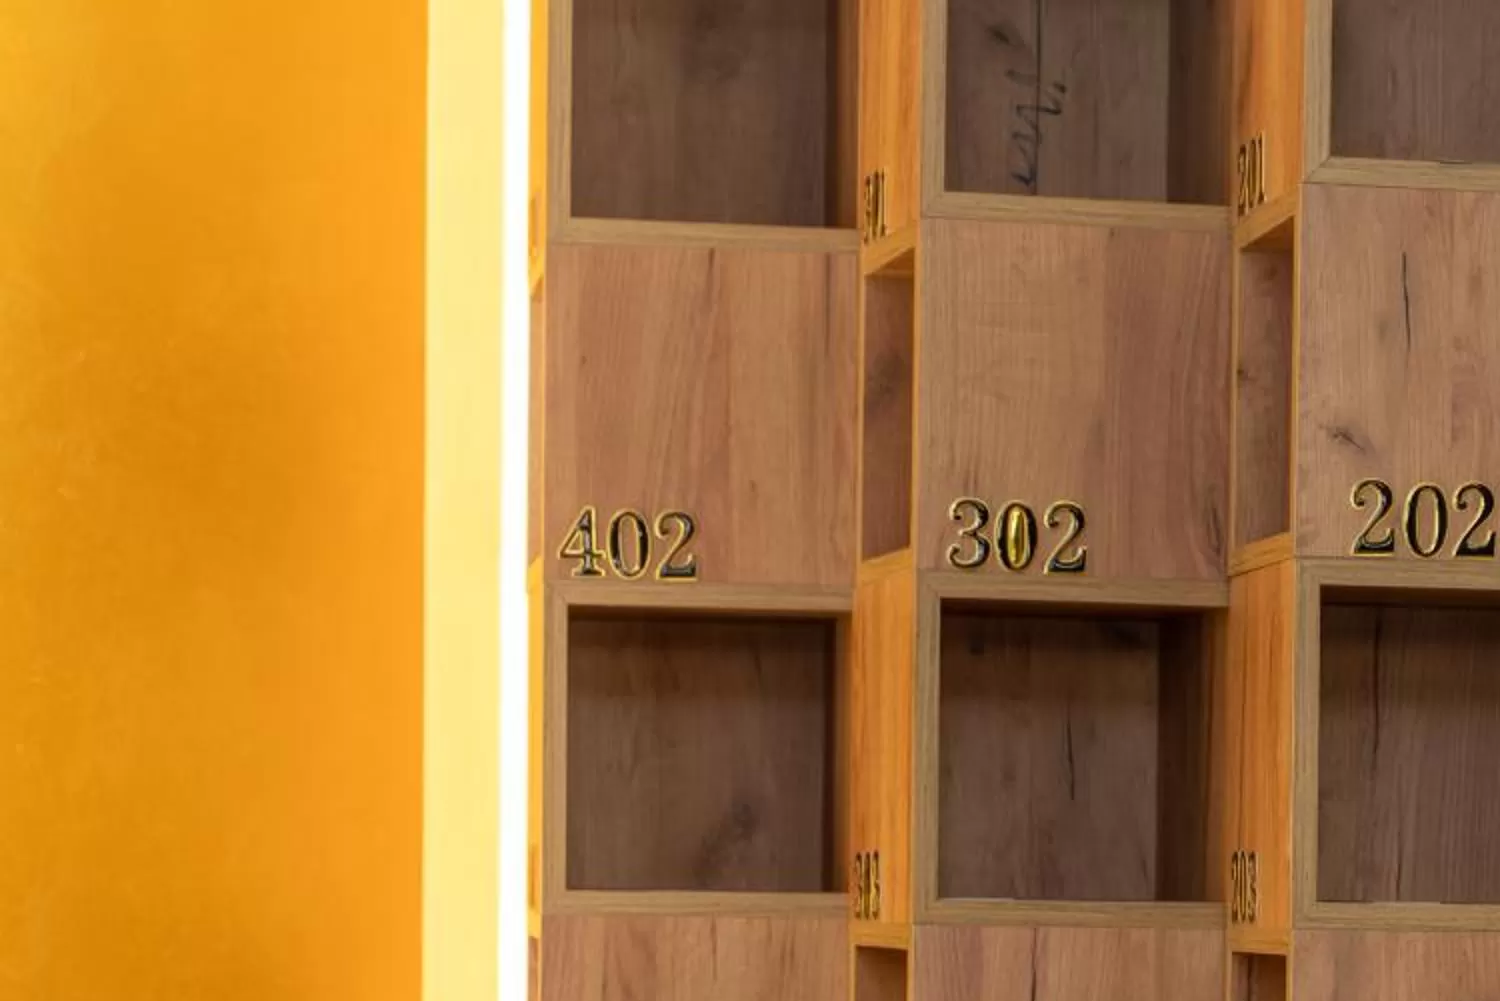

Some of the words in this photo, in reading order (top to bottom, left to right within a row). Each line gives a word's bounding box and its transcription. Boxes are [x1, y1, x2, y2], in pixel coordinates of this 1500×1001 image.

[1237, 130, 1267, 217] 201
[558, 505, 698, 581] 402
[948, 498, 1087, 574] 302
[1350, 477, 1497, 559] 202
[1230, 850, 1259, 925] 203
